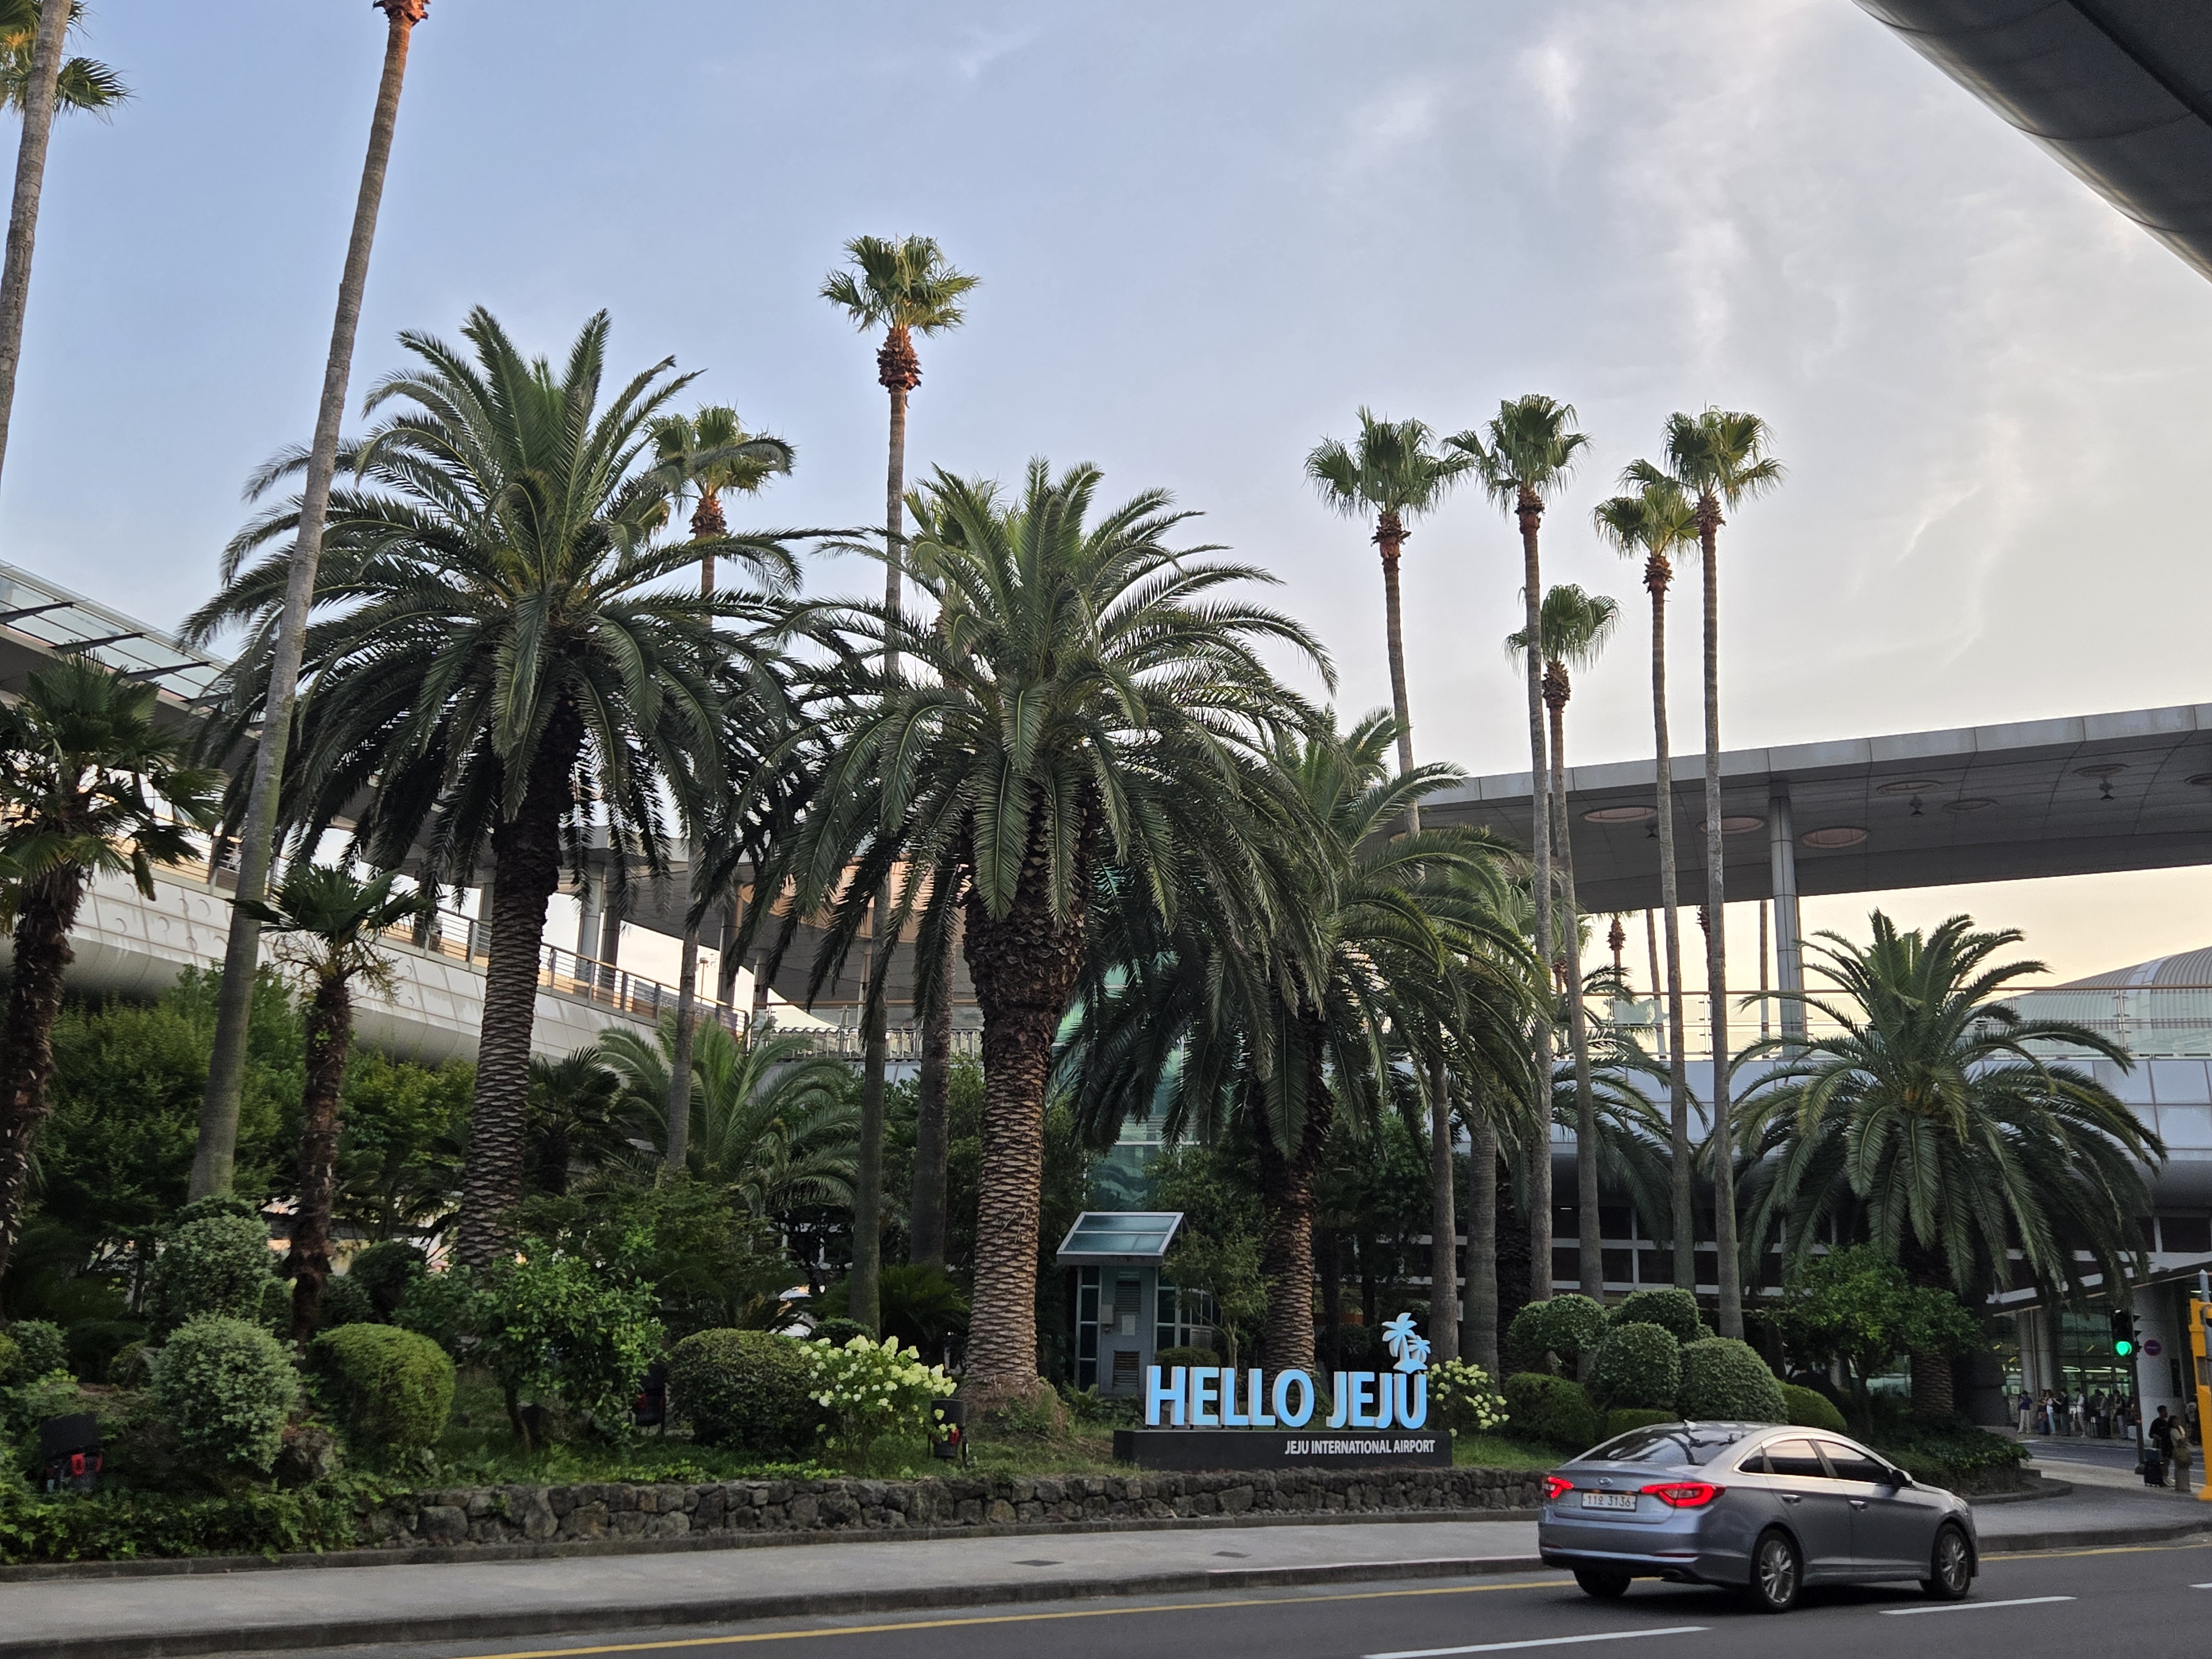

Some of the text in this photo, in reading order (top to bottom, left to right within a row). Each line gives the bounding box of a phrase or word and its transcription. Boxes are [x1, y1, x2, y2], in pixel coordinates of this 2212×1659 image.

[1145, 1365, 1427, 1429] HELLO JEJU
[1285, 1439, 1436, 1454] JEJU INTERNATIONAL AIRPORT
[1608, 1495, 1631, 1507] 3136
